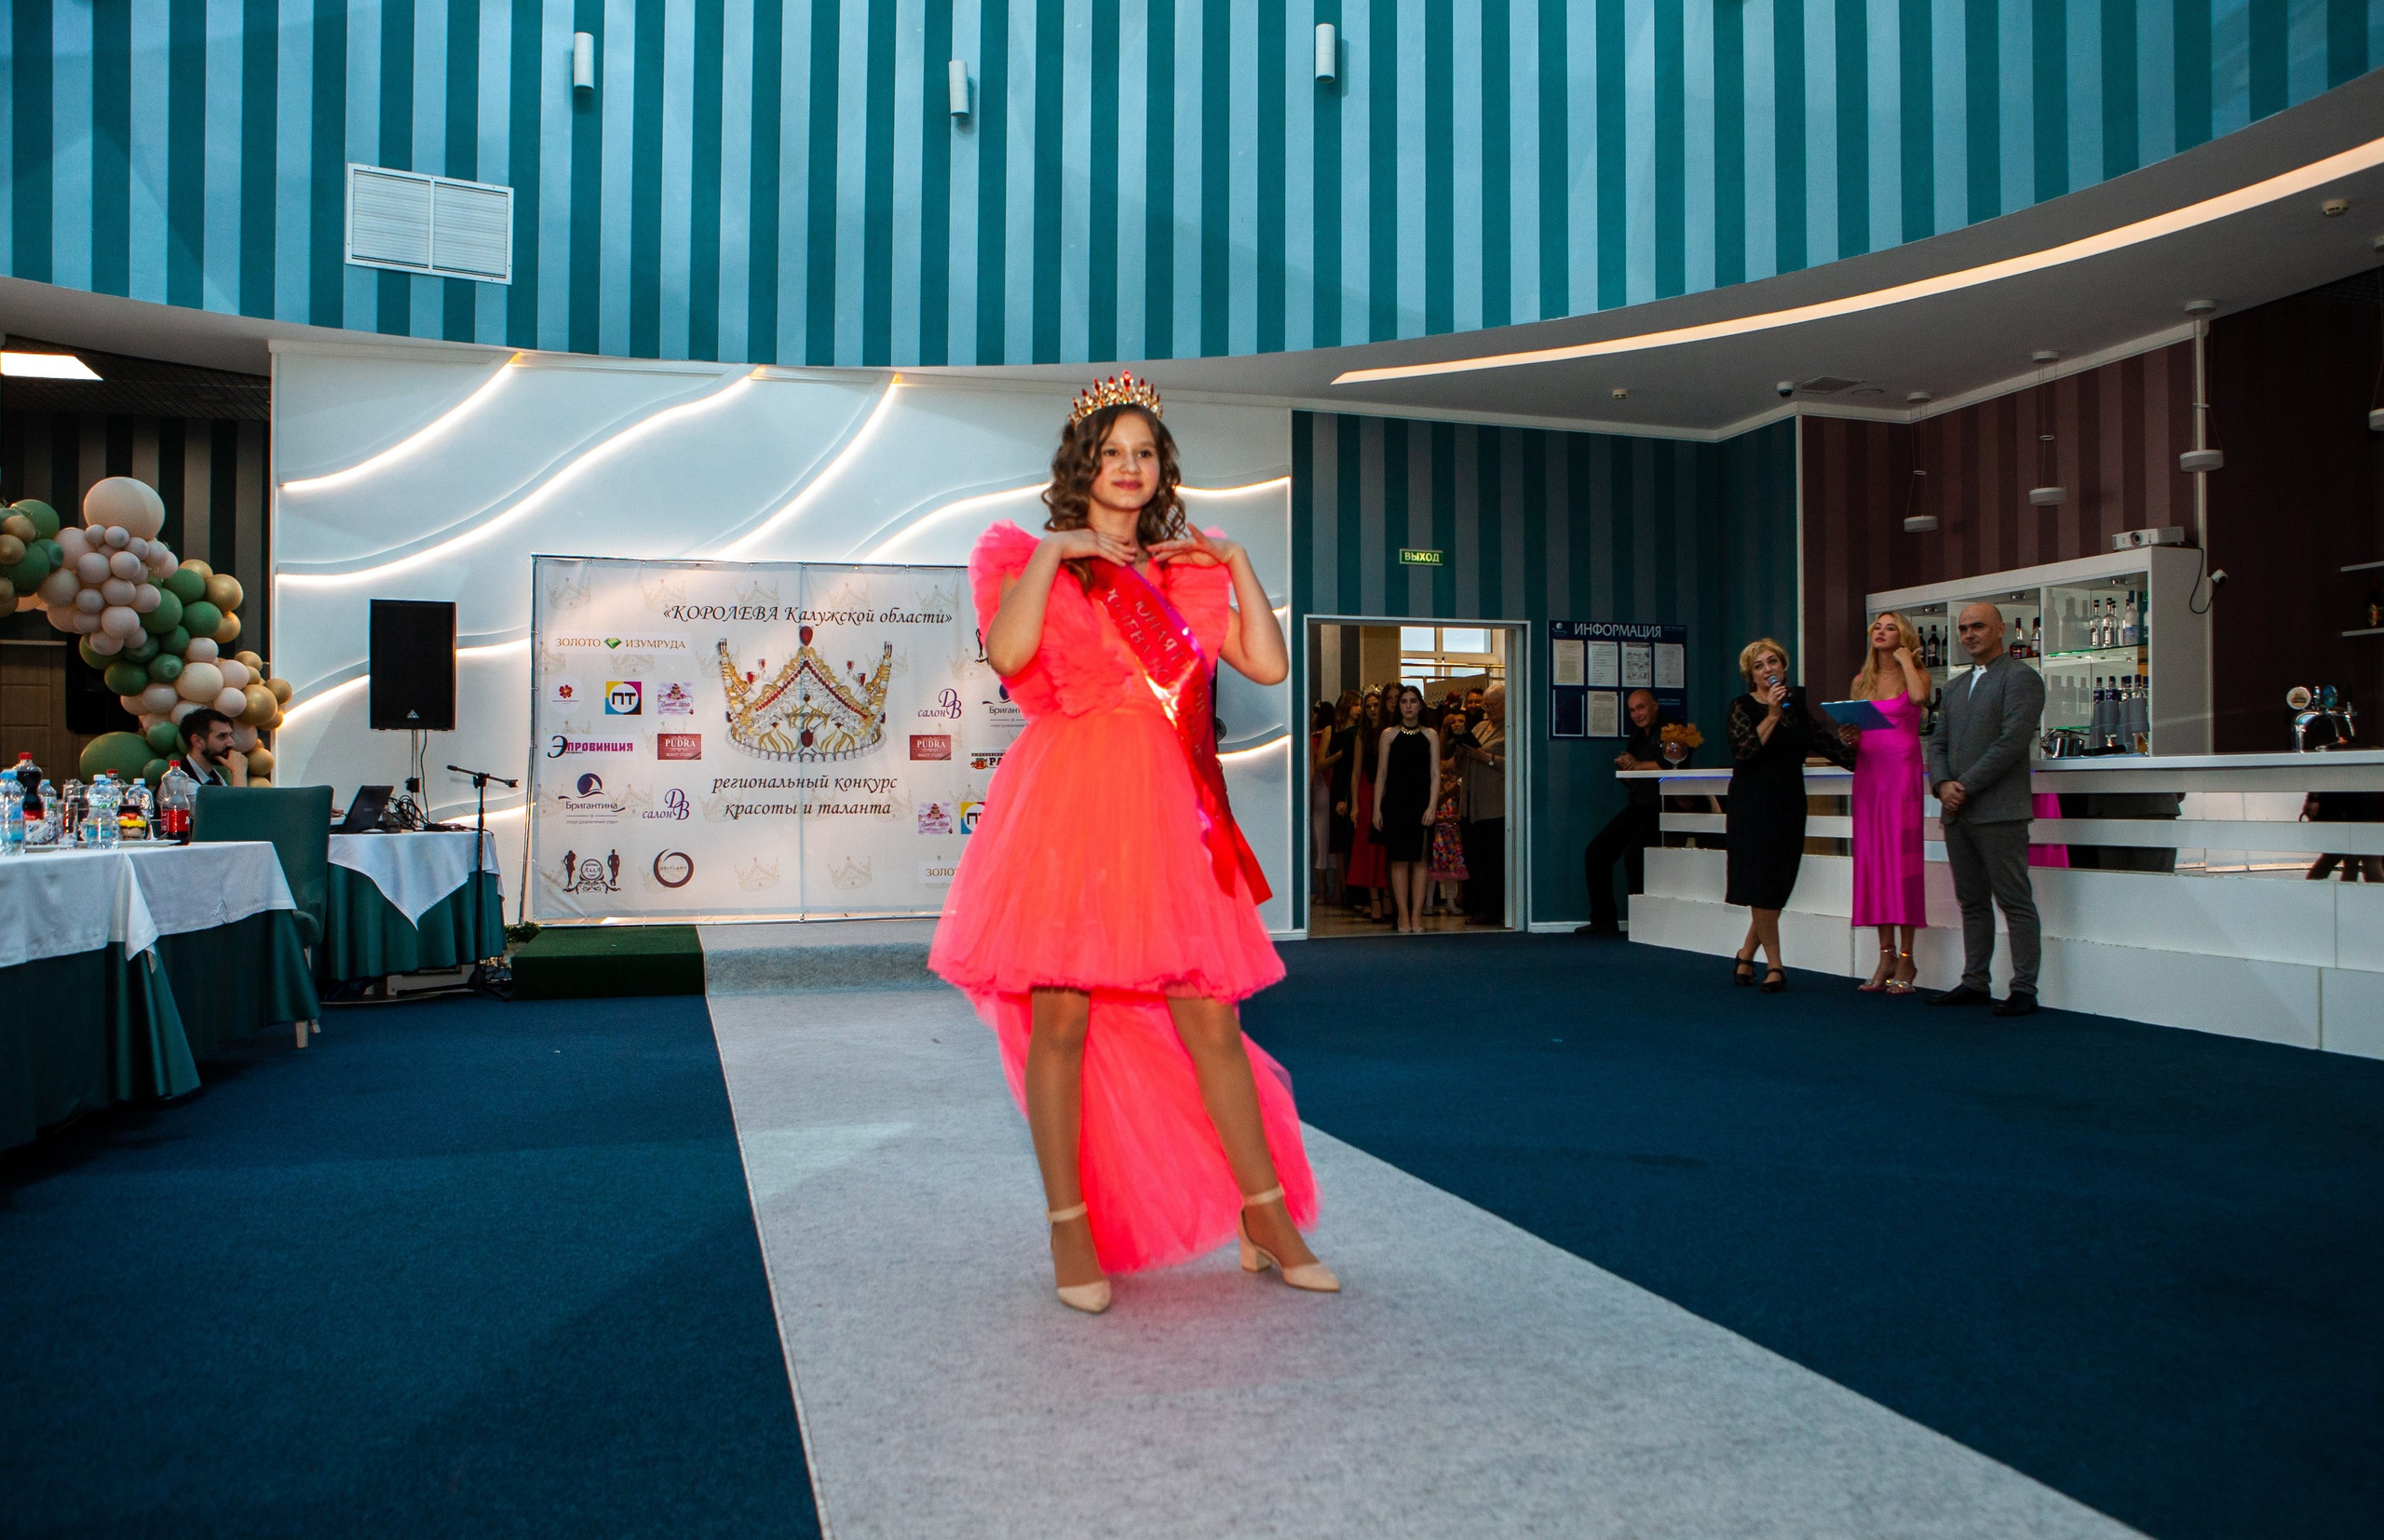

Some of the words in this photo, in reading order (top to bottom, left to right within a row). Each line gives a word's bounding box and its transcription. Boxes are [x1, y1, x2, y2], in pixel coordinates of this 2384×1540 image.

[1404, 552, 1440, 562] ВЫХОД
[663, 605, 779, 623] «КОРОЛЕВА
[784, 607, 875, 627] Калужской
[879, 607, 954, 624] области»
[1574, 623, 1662, 639] ИНФОРМАЦИЯ
[555, 638, 602, 648] ЗОЛОТО
[625, 640, 686, 650] ИЗУМРУДА
[612, 692, 637, 706] ПТ
[917, 709, 947, 718] салон
[989, 706, 1021, 715] Бригант
[665, 739, 697, 748] PUDRA
[916, 740, 946, 749] PUDRA
[711, 775, 830, 793] региональный
[834, 777, 898, 793] конкурс
[565, 801, 618, 812] Бригантина
[725, 803, 798, 819] красоты
[803, 803, 813, 815] и
[818, 803, 891, 816] таланта
[642, 809, 672, 819] салон
[926, 868, 958, 877] ЗОЛО
